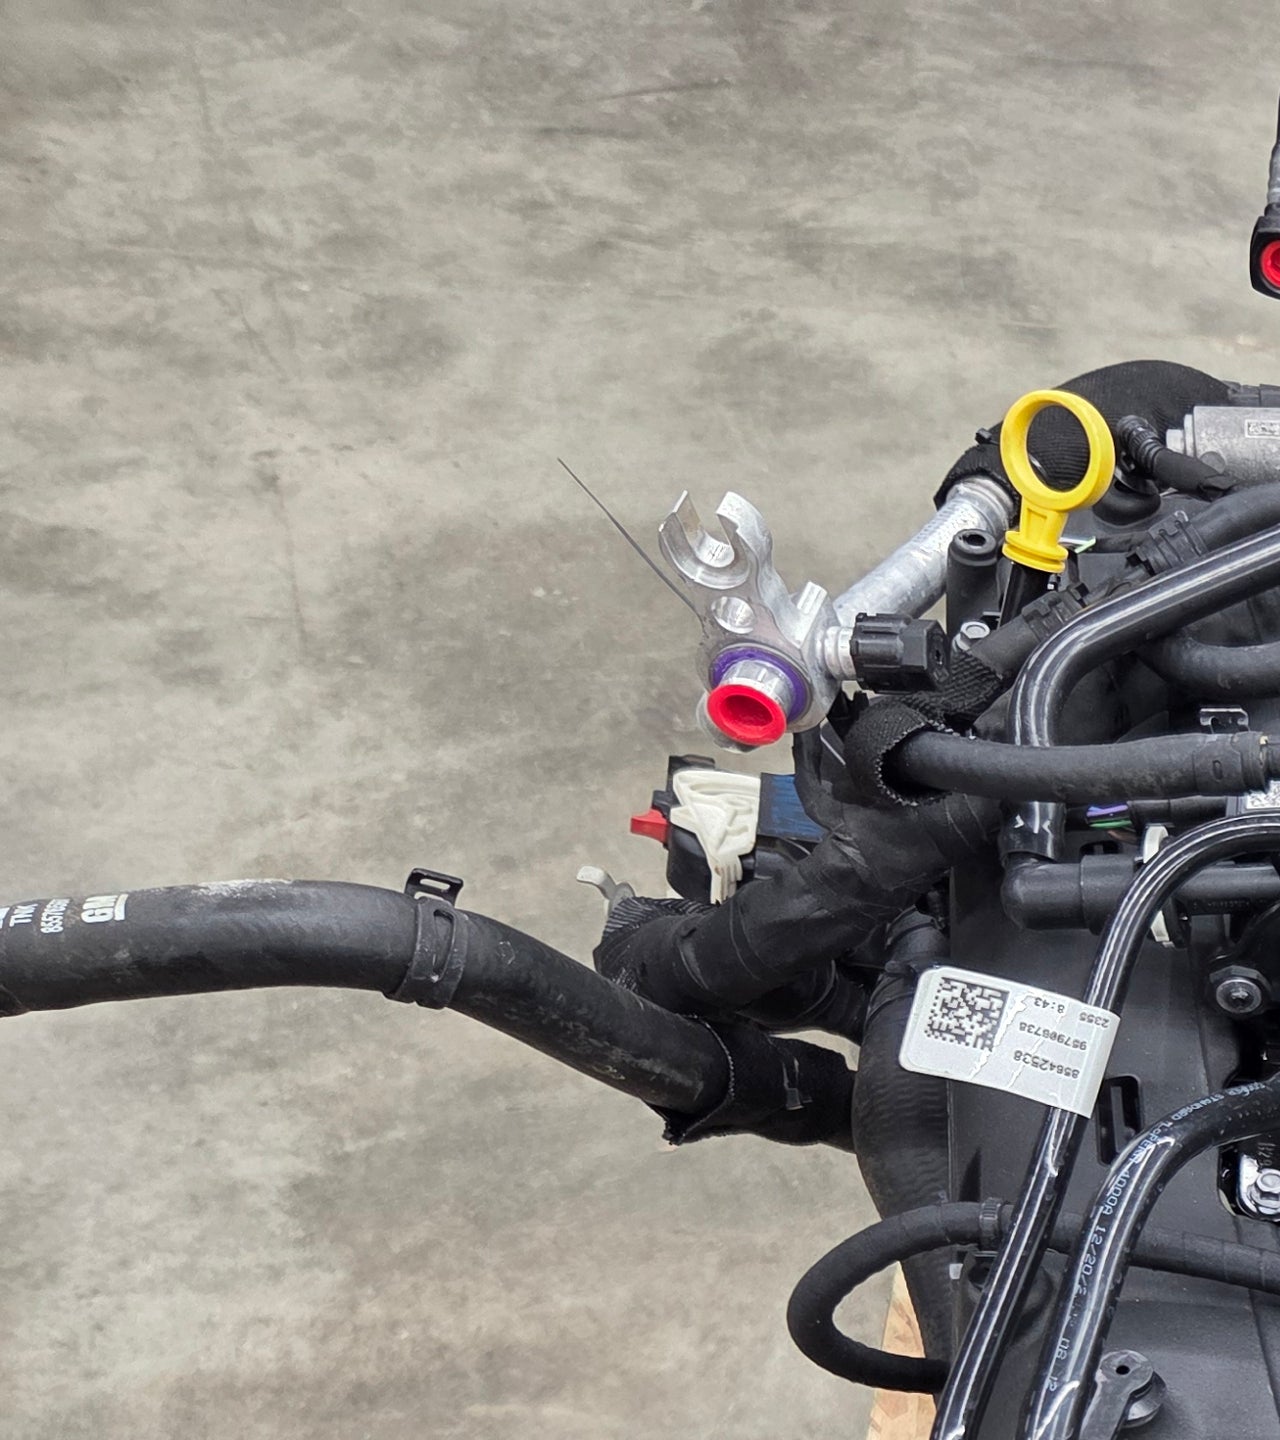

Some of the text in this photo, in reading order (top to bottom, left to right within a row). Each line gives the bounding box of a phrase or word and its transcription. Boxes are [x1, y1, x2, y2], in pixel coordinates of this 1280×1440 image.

[81, 894, 122, 924] GM
[1033, 996, 1111, 1029] 2355 8:43
[1013, 1049, 1080, 1079] 85642538
